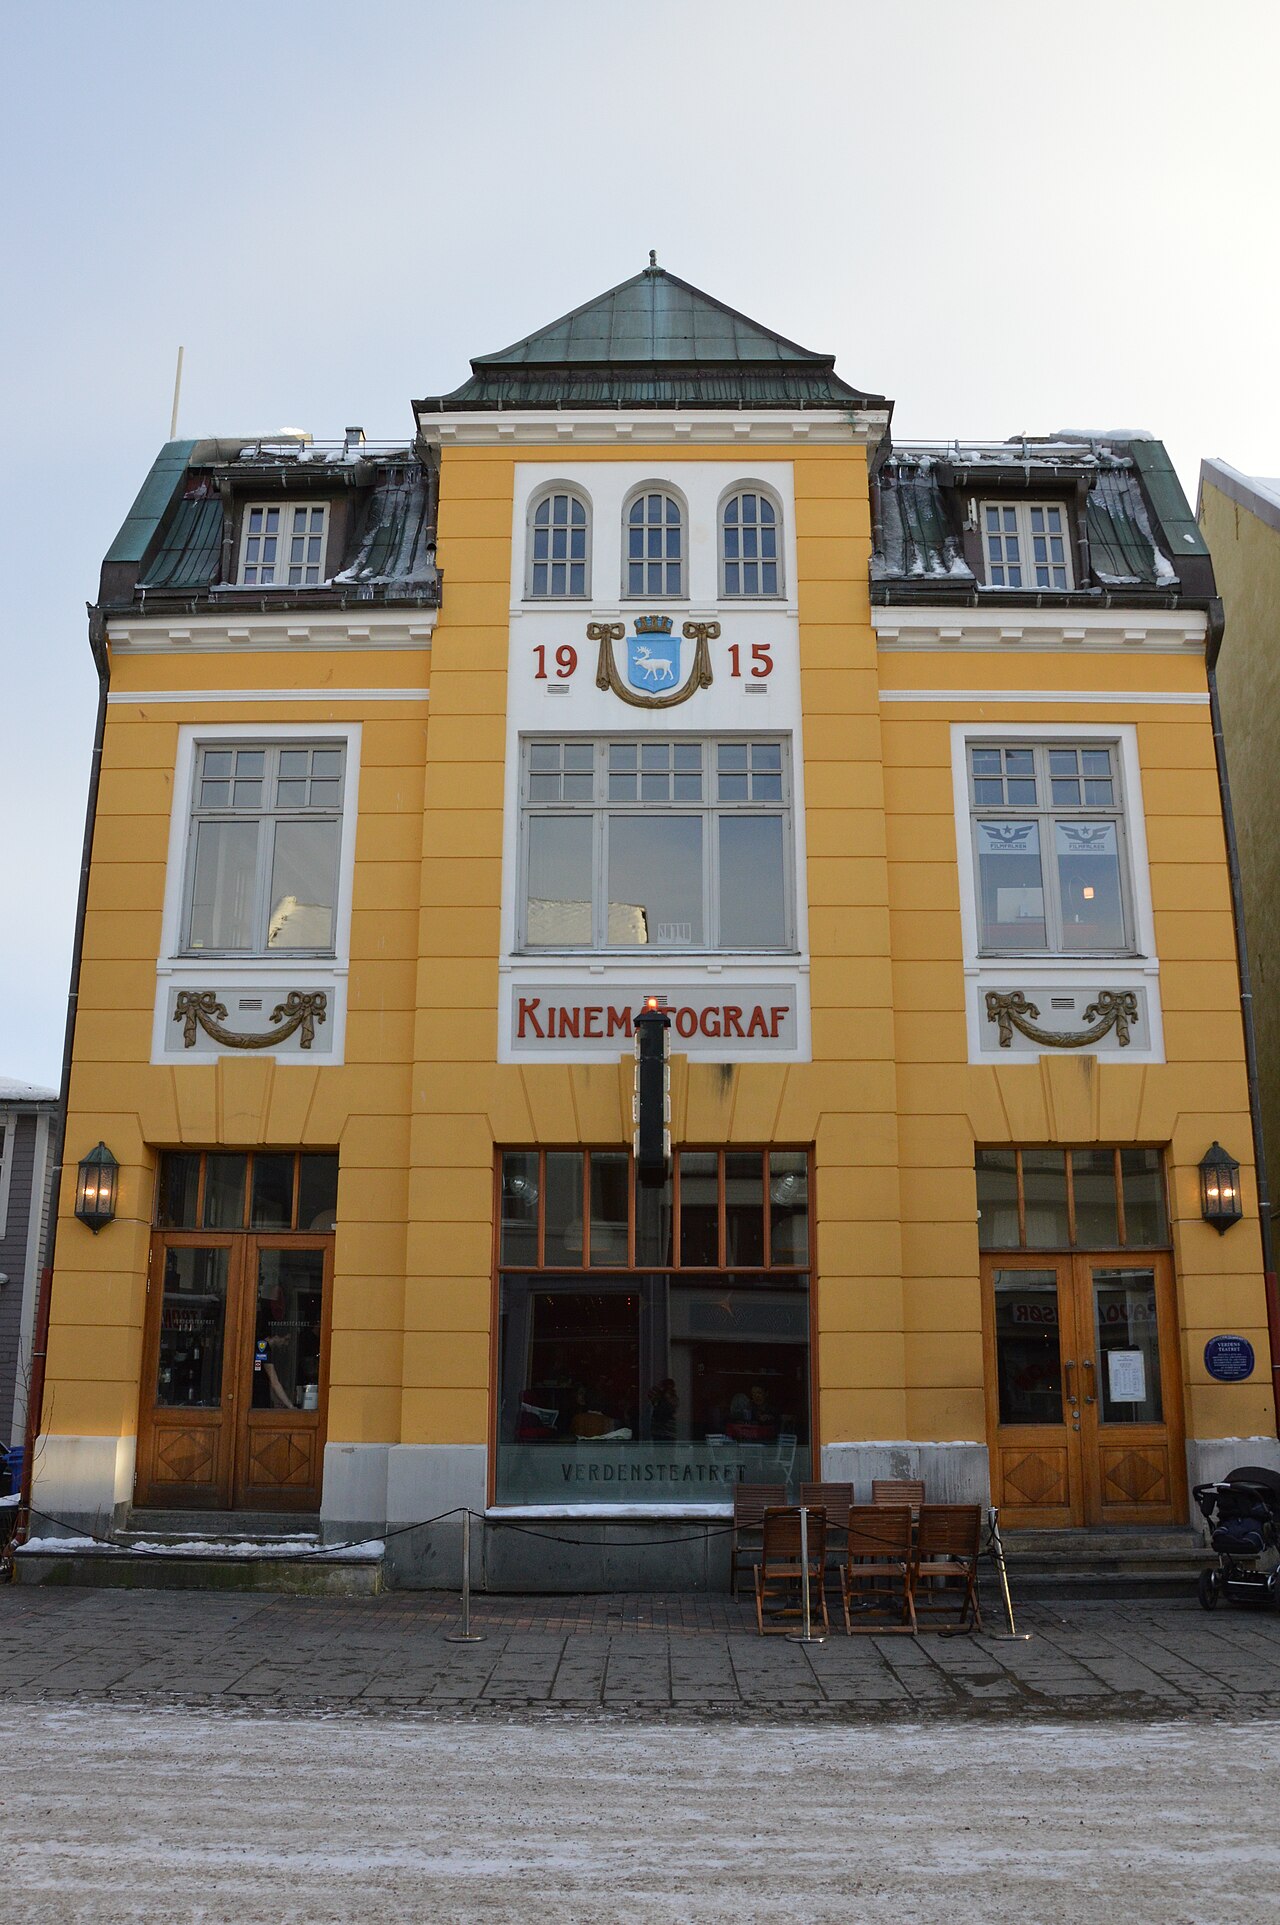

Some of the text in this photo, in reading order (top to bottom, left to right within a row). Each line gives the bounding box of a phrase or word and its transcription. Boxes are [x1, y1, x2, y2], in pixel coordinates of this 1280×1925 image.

[532, 643, 774, 679] 19 15
[561, 1463, 746, 1482] VERDENSTEATRET
